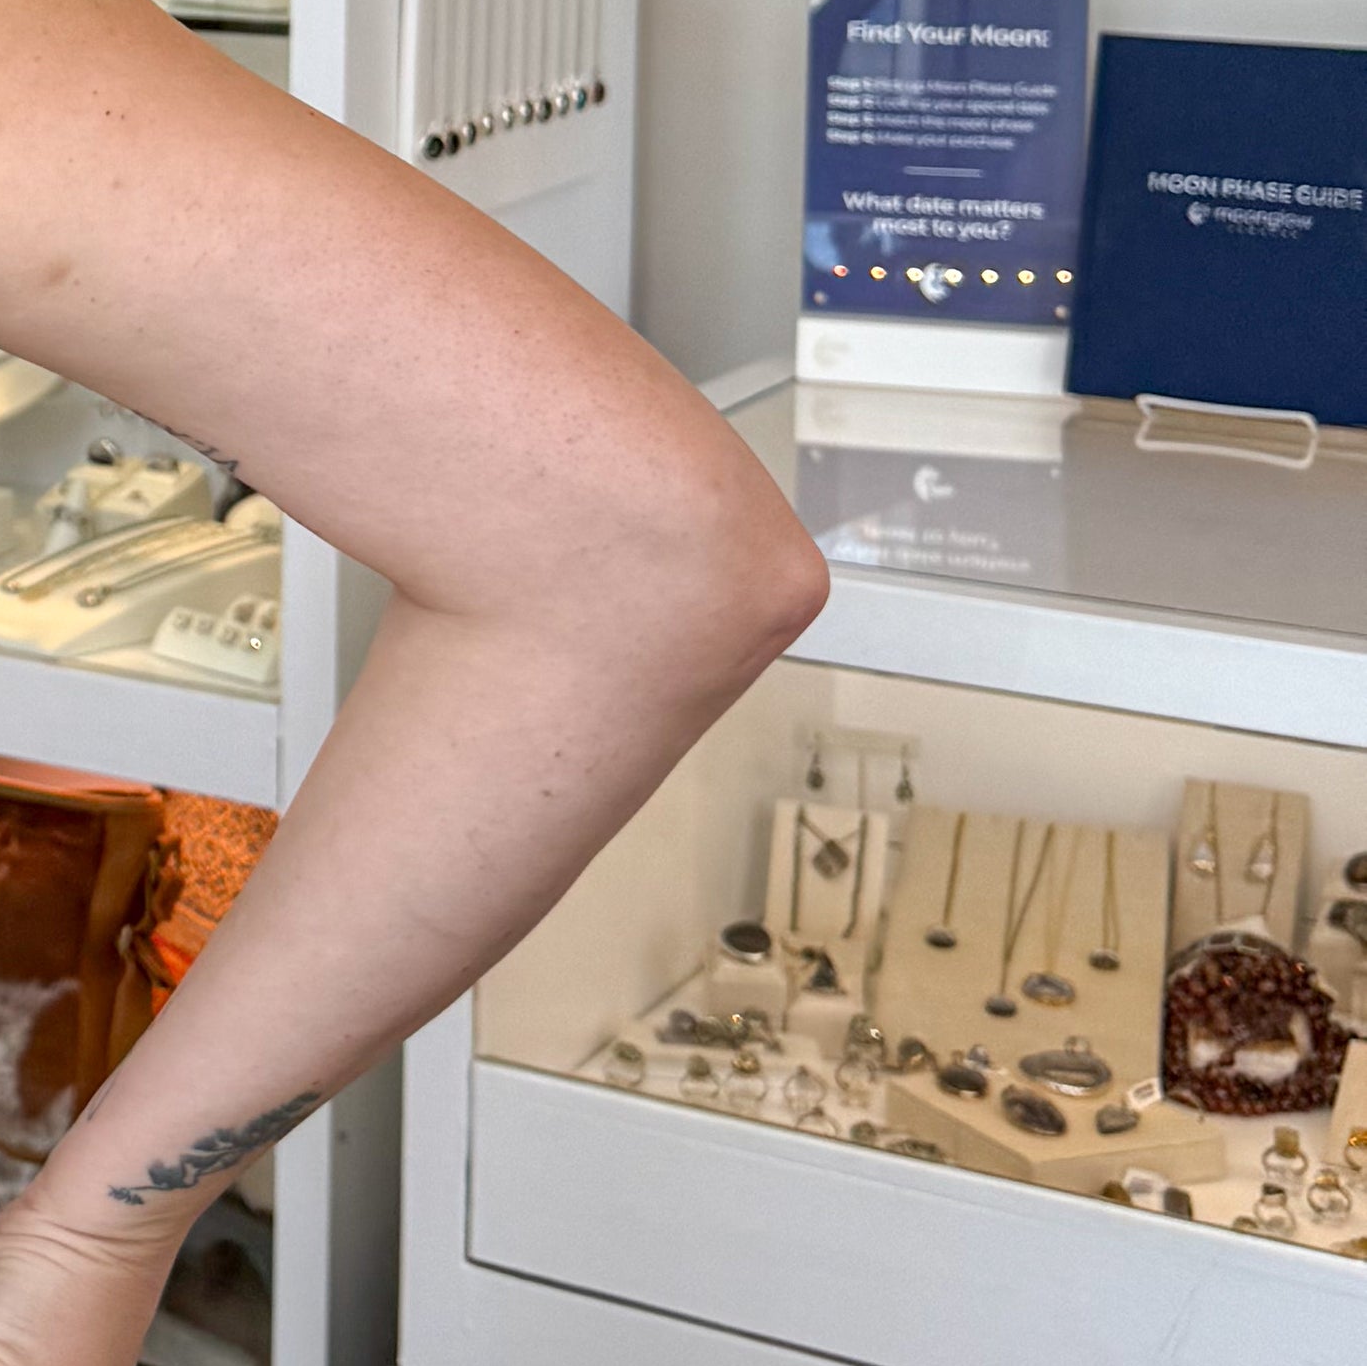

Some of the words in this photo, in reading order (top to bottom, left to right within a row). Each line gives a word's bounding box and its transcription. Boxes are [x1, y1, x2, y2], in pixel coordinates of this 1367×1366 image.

[846, 20, 903, 44] Find
[906, 21, 966, 46] Your
[842, 190, 905, 214] What
[906, 193, 956, 216] date
[958, 198, 1046, 221] matters
[1147, 172, 1218, 198] MOON
[1222, 177, 1293, 204] PHASE
[1294, 185, 1365, 211] GUIDE
[872, 217, 931, 237] most
[932, 219, 957, 238] to
